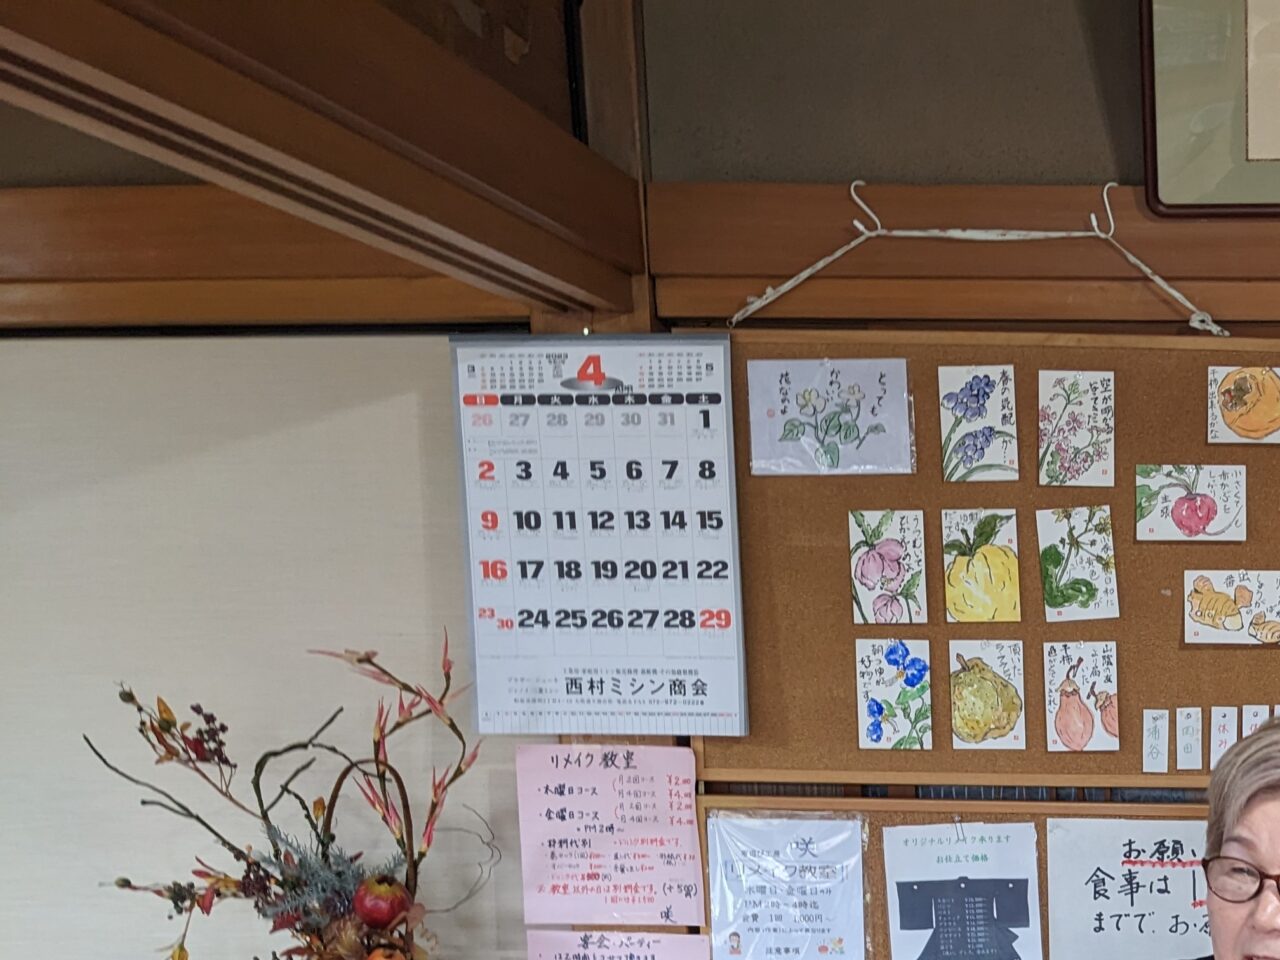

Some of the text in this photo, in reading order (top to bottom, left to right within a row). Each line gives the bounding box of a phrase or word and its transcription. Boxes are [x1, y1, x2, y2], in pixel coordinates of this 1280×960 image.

[577, 355, 606, 387] 4
[699, 410, 711, 428] 1
[478, 460, 716, 481] 2 3 4 5 6 7 8
[481, 511, 723, 530] 9 10 11 12 13 14 15
[479, 560, 729, 580] 16 17 18 19 20 21 22
[478, 608, 495, 619] 23
[518, 609, 732, 628] 24 25 26 27 28 29
[565, 677, 708, 697] 西村ミシン商会
[550, 750, 638, 770] リメイク教室
